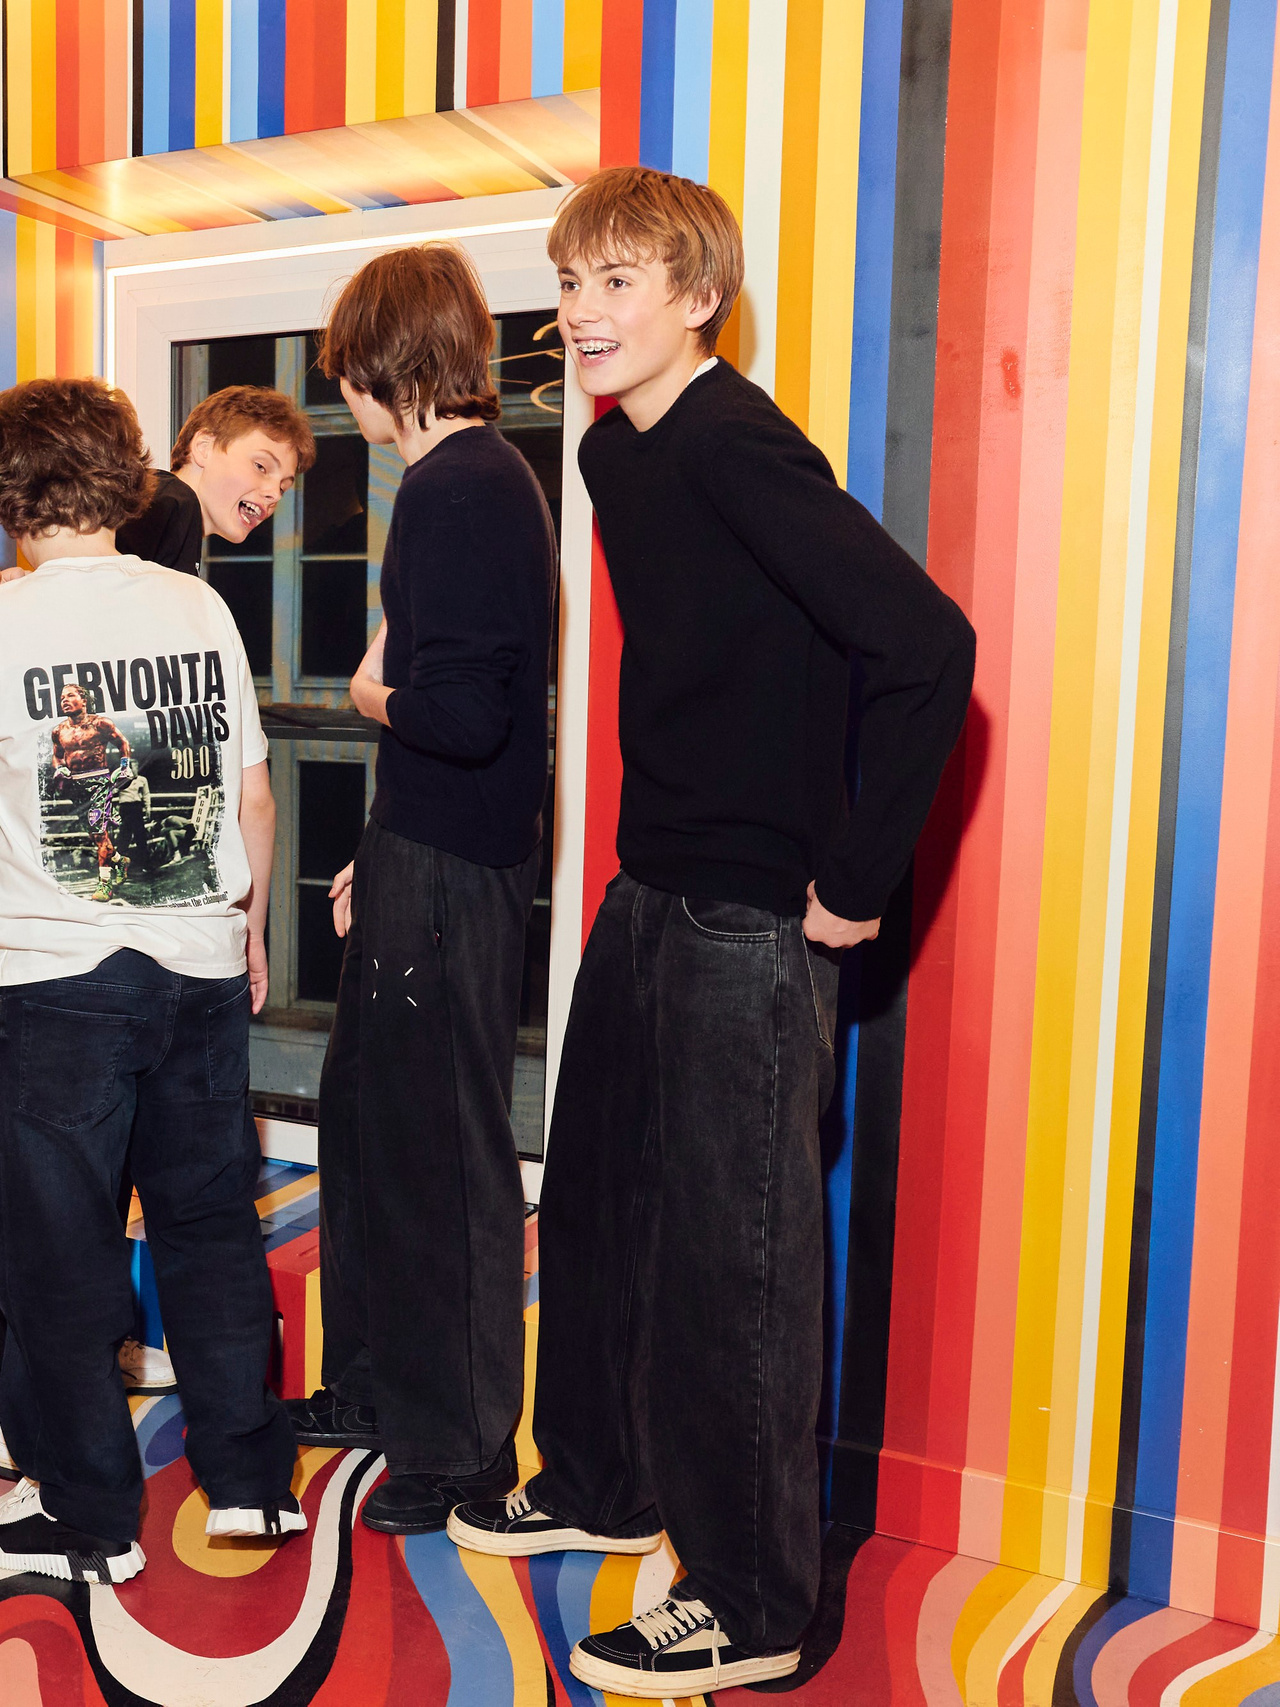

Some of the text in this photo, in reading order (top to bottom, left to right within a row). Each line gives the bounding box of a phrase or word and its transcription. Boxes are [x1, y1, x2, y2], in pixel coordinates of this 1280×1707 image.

[23, 650, 226, 721] GERVONTA
[145, 702, 230, 749] DAVIS
[191, 897, 203, 907] the
